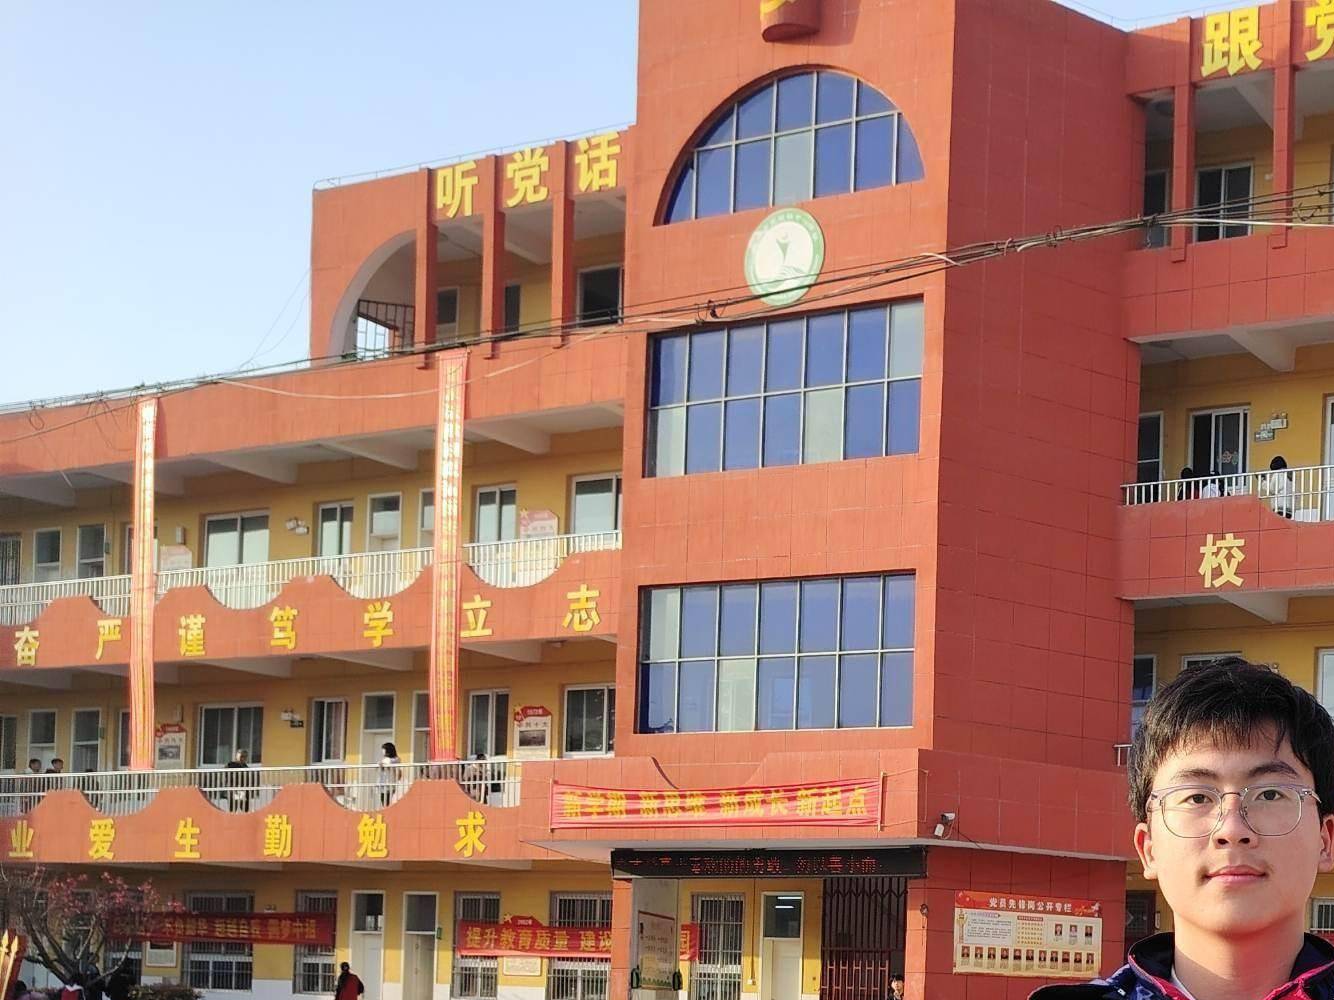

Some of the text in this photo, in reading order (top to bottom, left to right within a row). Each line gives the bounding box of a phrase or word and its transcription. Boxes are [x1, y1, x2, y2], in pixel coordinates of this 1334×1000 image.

[435, 131, 621, 218] 听党话
[563, 790, 627, 818] 新学期
[796, 787, 869, 818] 新起点
[466, 926, 570, 951] 提升教育质量
